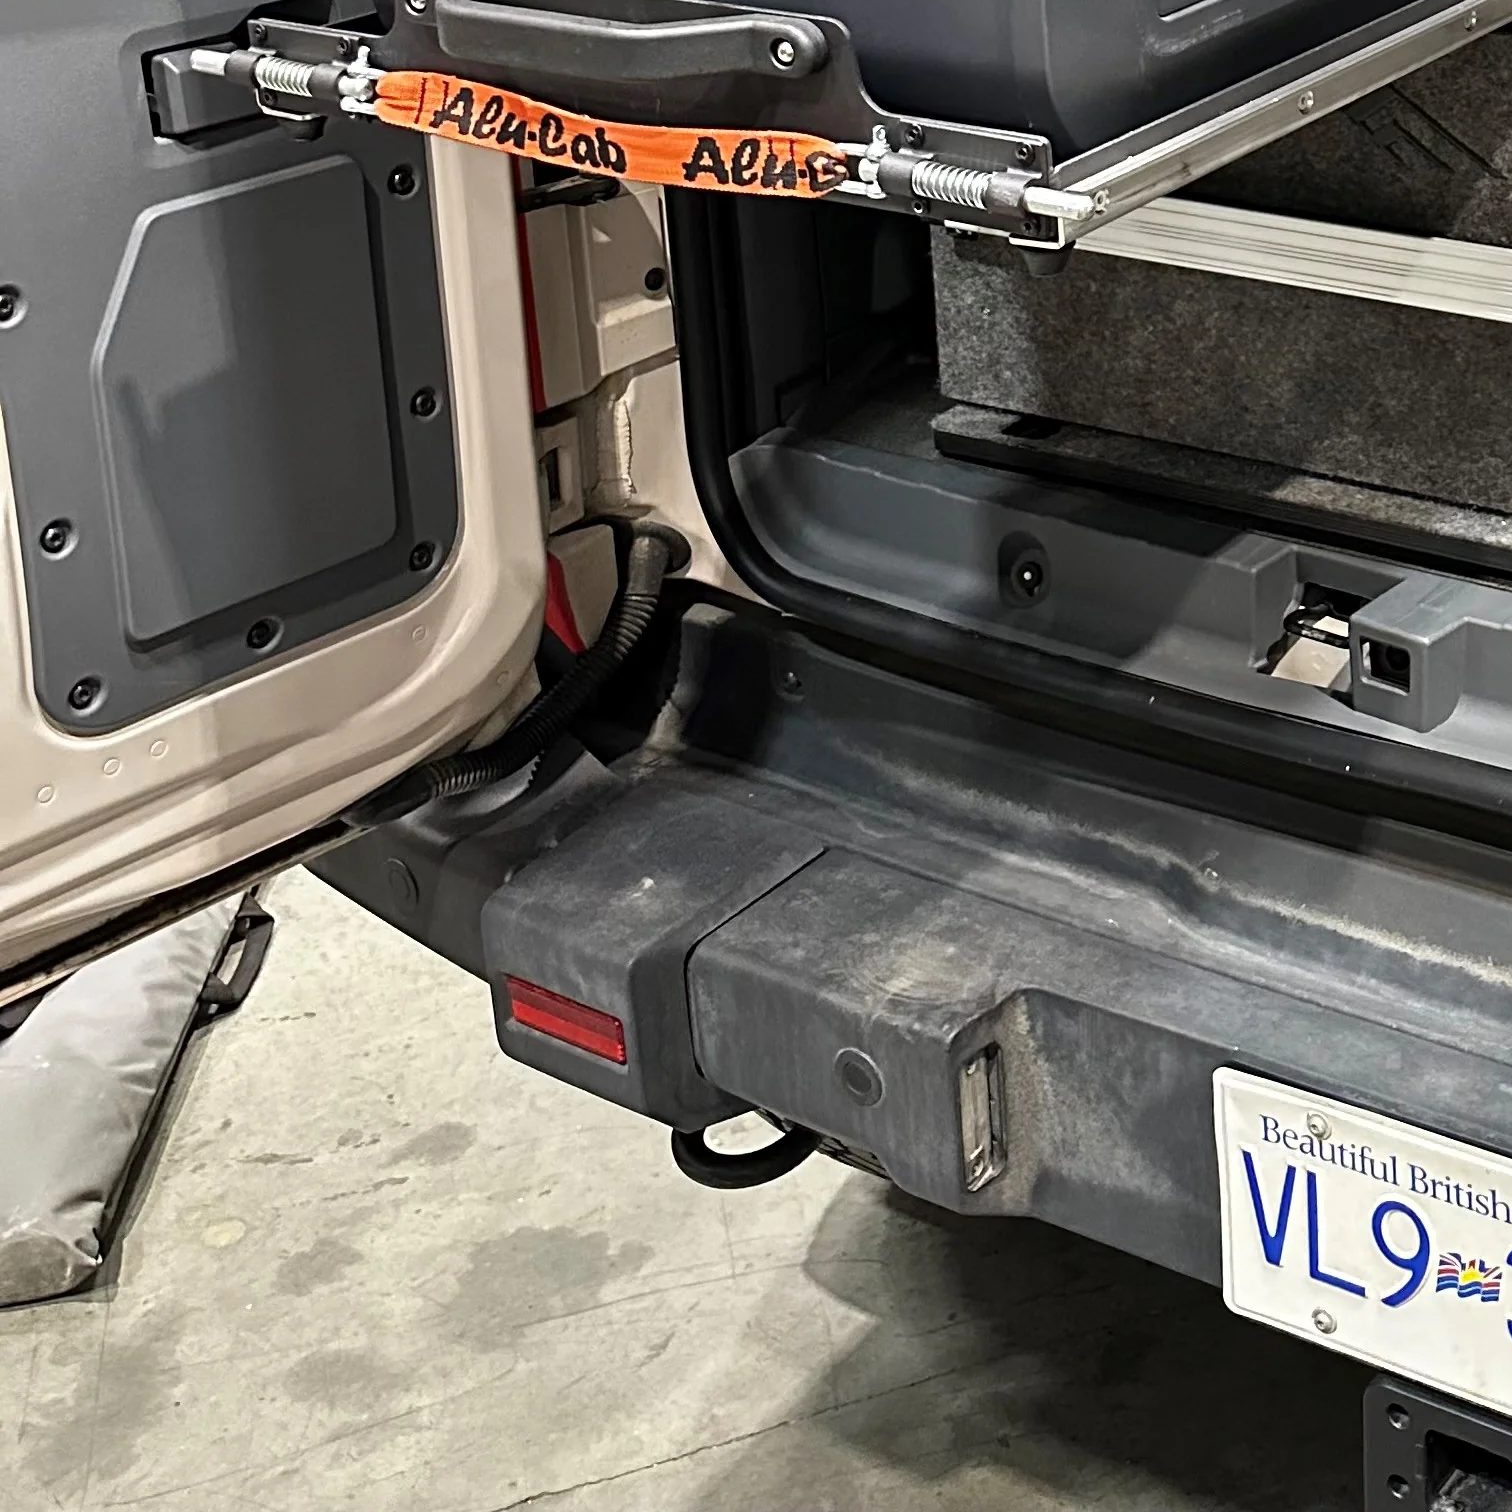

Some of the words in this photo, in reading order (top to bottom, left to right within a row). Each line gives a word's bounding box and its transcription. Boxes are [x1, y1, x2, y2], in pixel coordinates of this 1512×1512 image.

[431, 86, 626, 173] Alu-Cab
[1259, 1114, 1398, 1186] Beautiful
[1408, 1164, 1512, 1226] British
[1242, 1149, 1432, 1307] VL9
